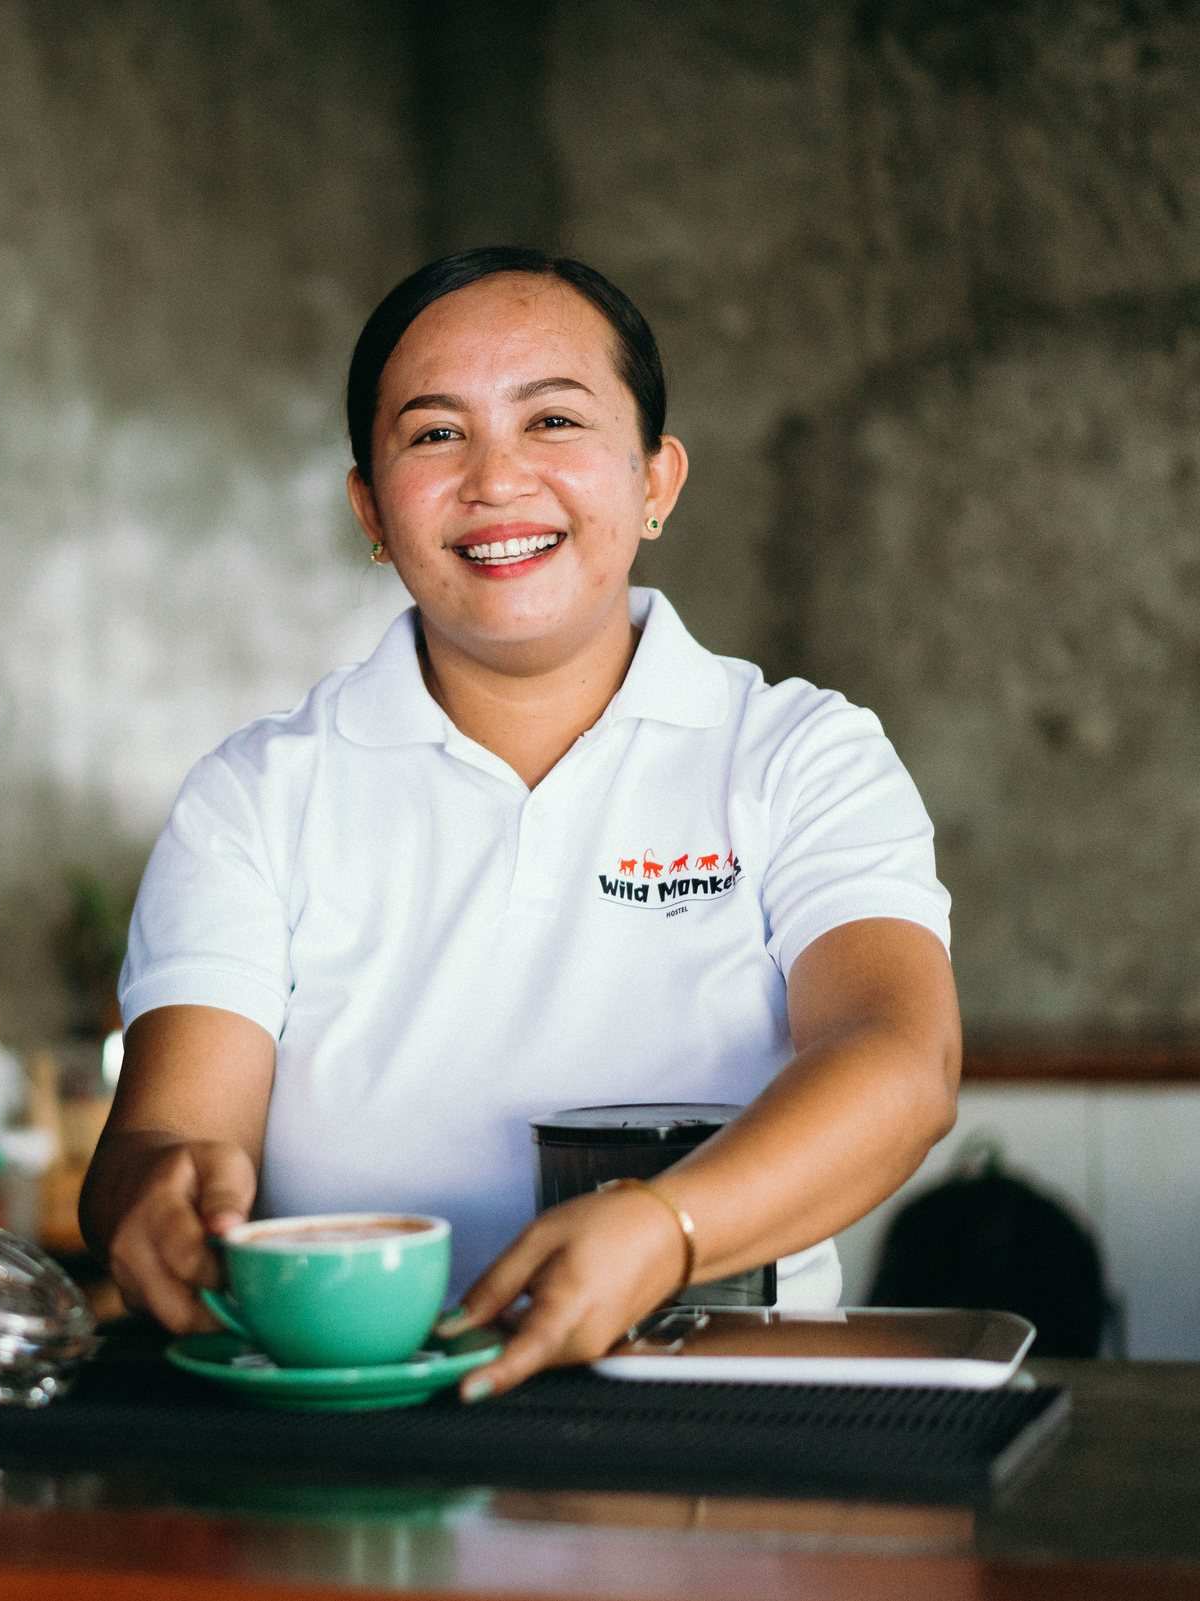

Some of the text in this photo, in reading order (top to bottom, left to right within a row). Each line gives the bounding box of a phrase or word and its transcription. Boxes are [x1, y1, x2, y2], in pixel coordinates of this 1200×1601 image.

[599, 856, 741, 903] Wild Monkes
[666, 906, 688, 918] HOSTEL
